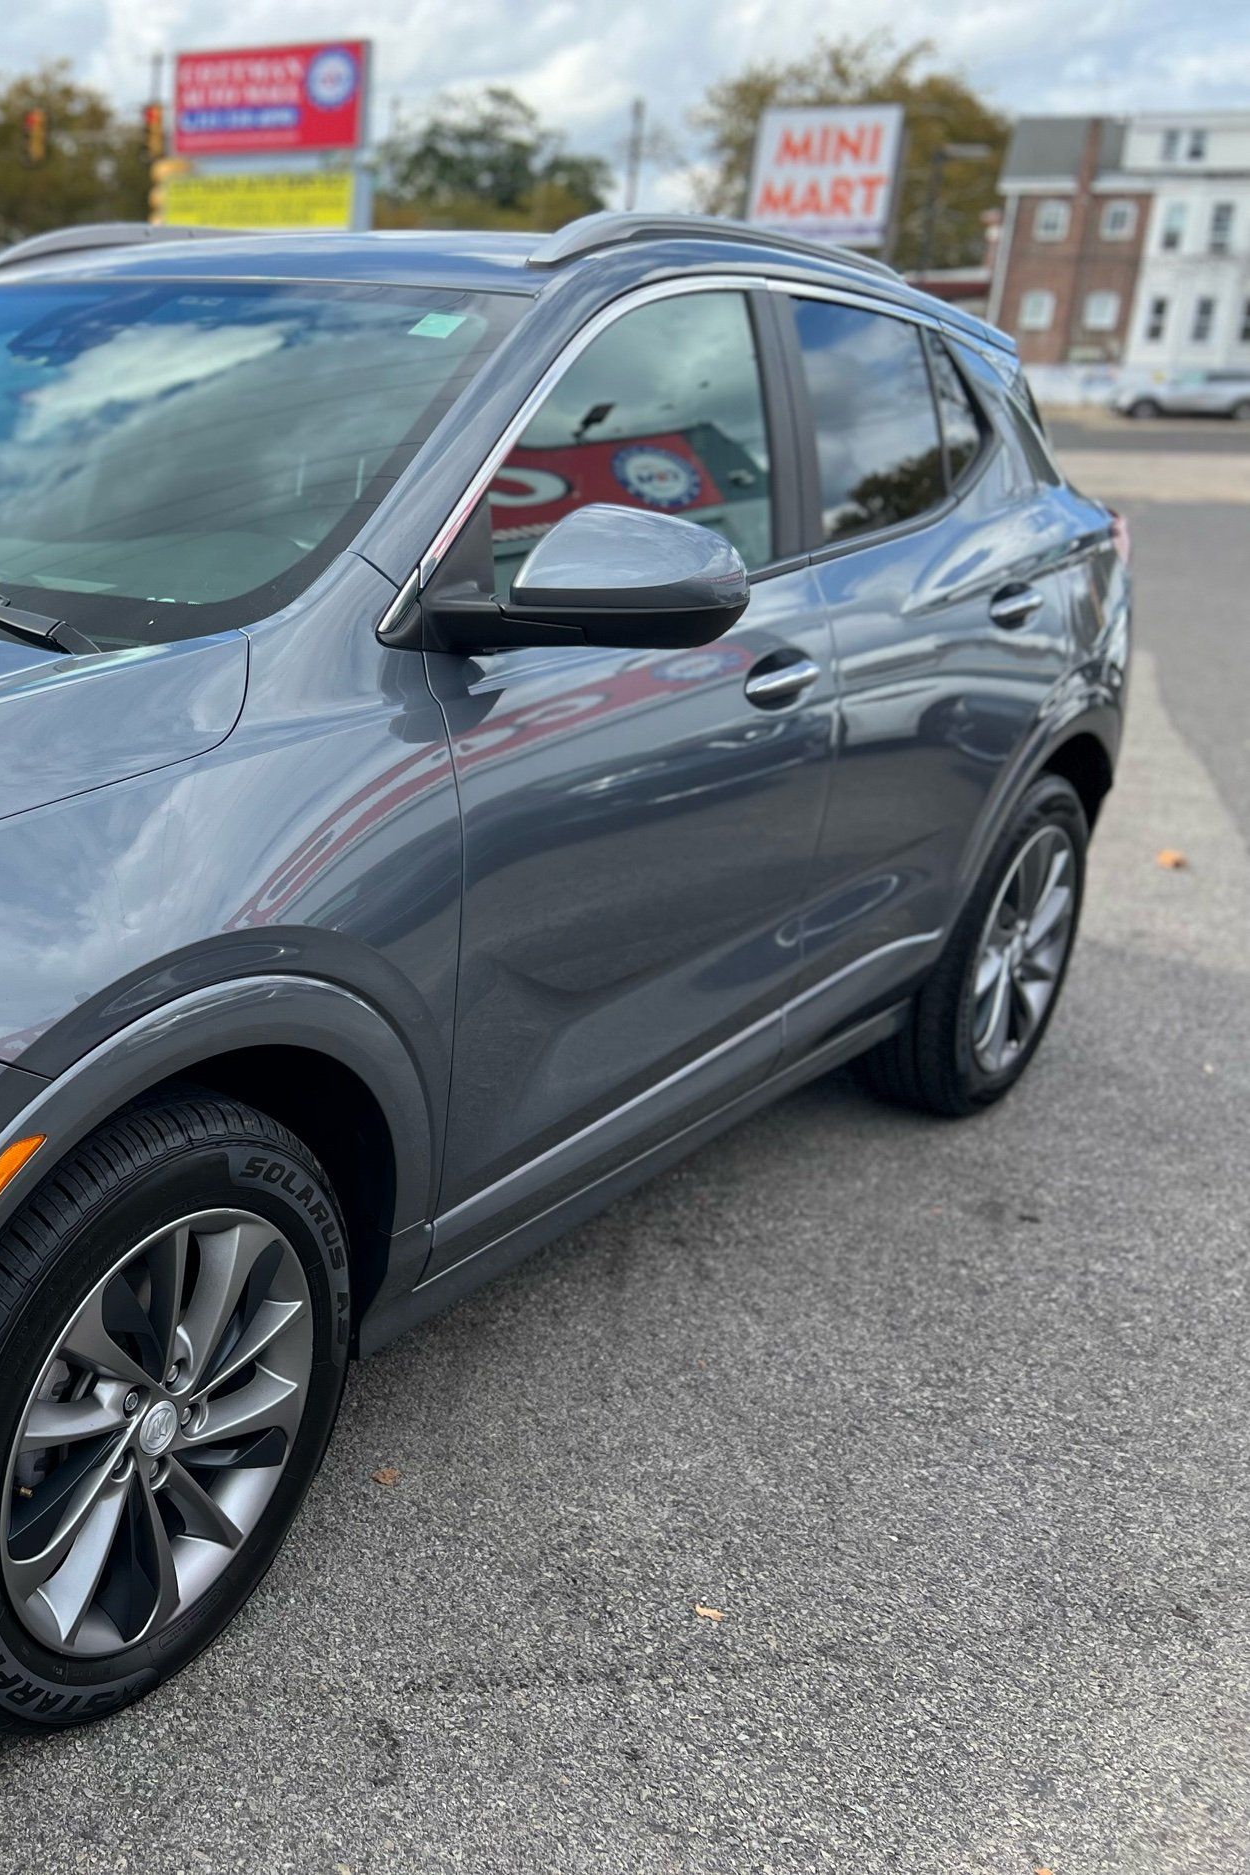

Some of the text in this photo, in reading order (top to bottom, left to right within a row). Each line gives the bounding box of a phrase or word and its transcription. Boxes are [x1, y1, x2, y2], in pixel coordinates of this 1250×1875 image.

[774, 122, 884, 167] MINI
[756, 174, 889, 218] MART
[238, 1156, 350, 1346] SOLARUS AS
